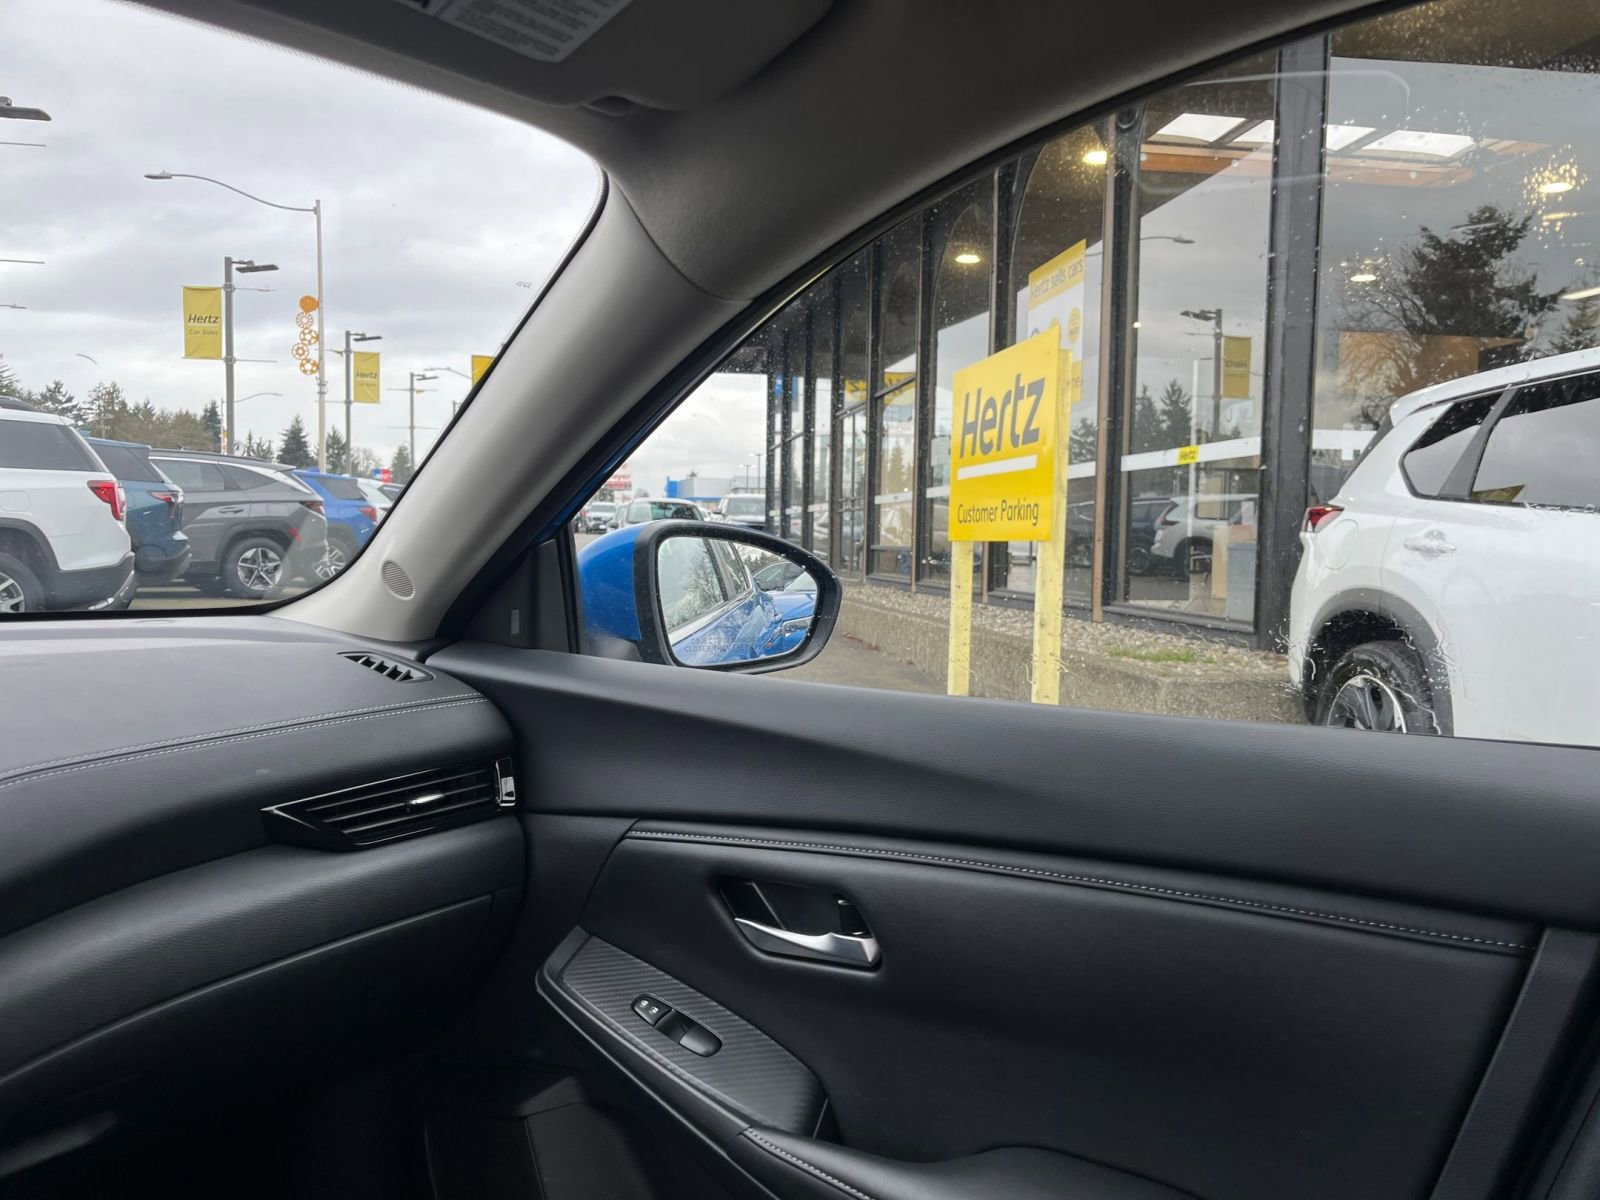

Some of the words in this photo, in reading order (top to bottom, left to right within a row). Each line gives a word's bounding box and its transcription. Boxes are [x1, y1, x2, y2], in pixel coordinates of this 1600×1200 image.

[1067, 258, 1084, 280] cars
[188, 313, 220, 325] Hertz
[356, 369, 378, 379] Hertz
[959, 373, 1046, 459] Hertz
[957, 504, 998, 524] Customer
[1000, 498, 1039, 527] Parking
